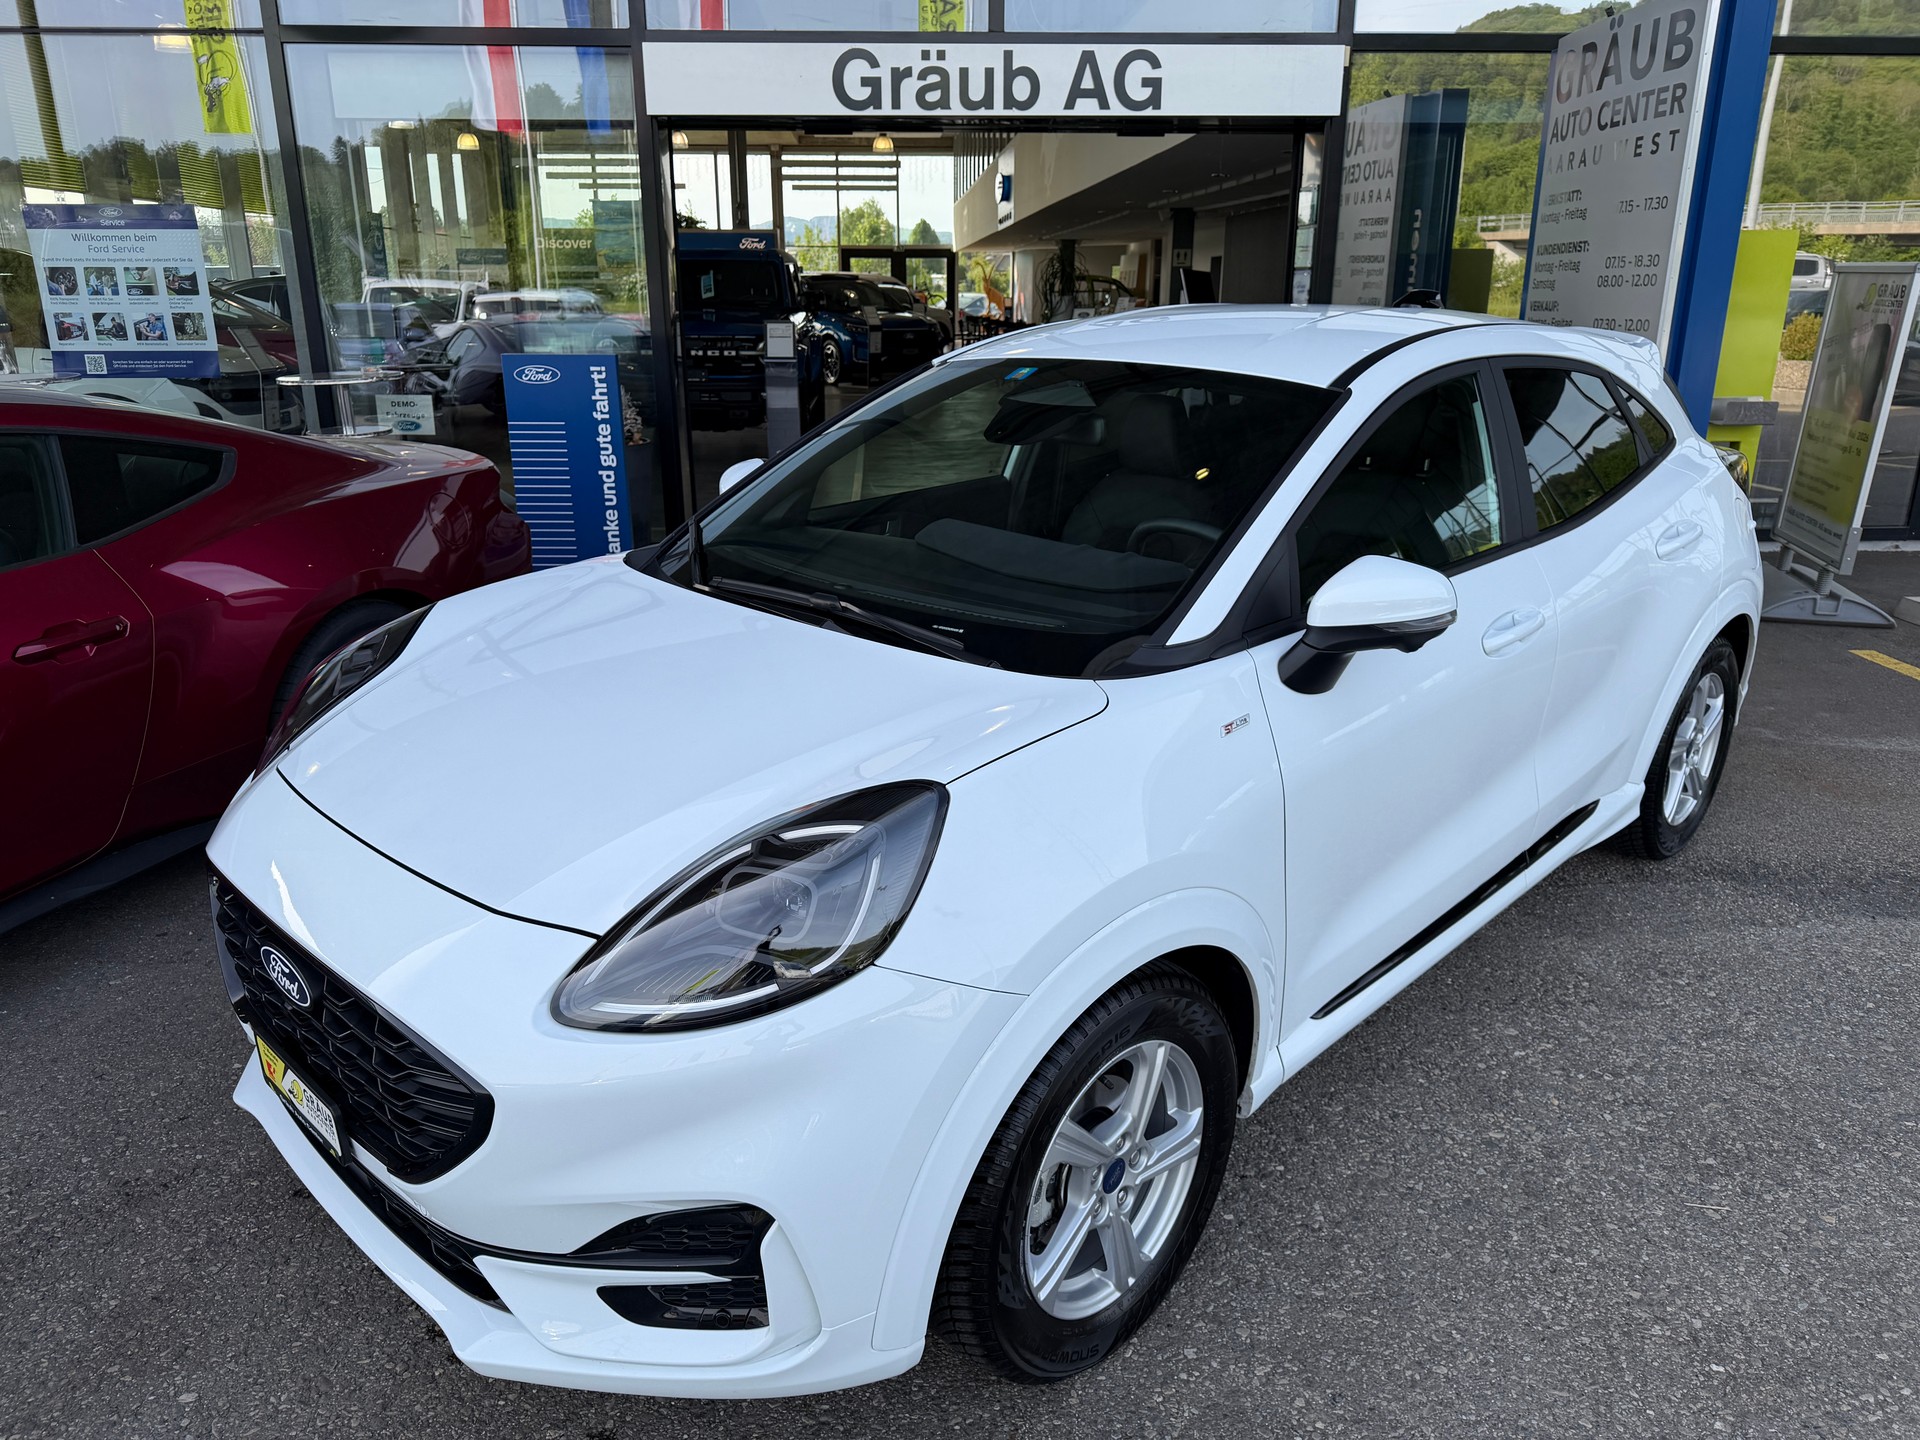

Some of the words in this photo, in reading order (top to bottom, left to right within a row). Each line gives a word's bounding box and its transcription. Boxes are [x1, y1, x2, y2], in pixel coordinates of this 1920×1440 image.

[1556, 8, 1696, 105] GRÄUB
[832, 48, 1041, 111] Gräub
[1063, 49, 1162, 111] AG
[1550, 105, 1592, 145] AUTO
[1597, 82, 1687, 131] CENTER
[1547, 189, 1582, 206] ERKSTATT:
[1644, 195, 1669, 211] 17.30
[1564, 207, 1588, 221] Freitag
[71, 233, 132, 242] Willkommen
[134, 233, 157, 242] beim
[739, 238, 767, 249] Ford
[88, 245, 109, 253] Ford
[112, 245, 145, 253] Service
[1536, 240, 1590, 256] KUNDENDIENST:
[1534, 261, 1554, 275] Montag
[1558, 259, 1581, 273] Freitag
[1605, 256, 1626, 269] 07.15
[1532, 278, 1556, 291] Samstag
[1597, 274, 1624, 288] 08.00
[1631, 273, 1658, 287] 12.00
[1529, 301, 1560, 312] VERKAUF:
[1624, 319, 1650, 332] 12.00
[522, 367, 552, 381] Ford
[589, 366, 610, 420] fahrt!
[598, 423, 617, 468] gute
[598, 470, 617, 507] und
[602, 509, 622, 556] anke
[269, 954, 300, 1000] Ford
